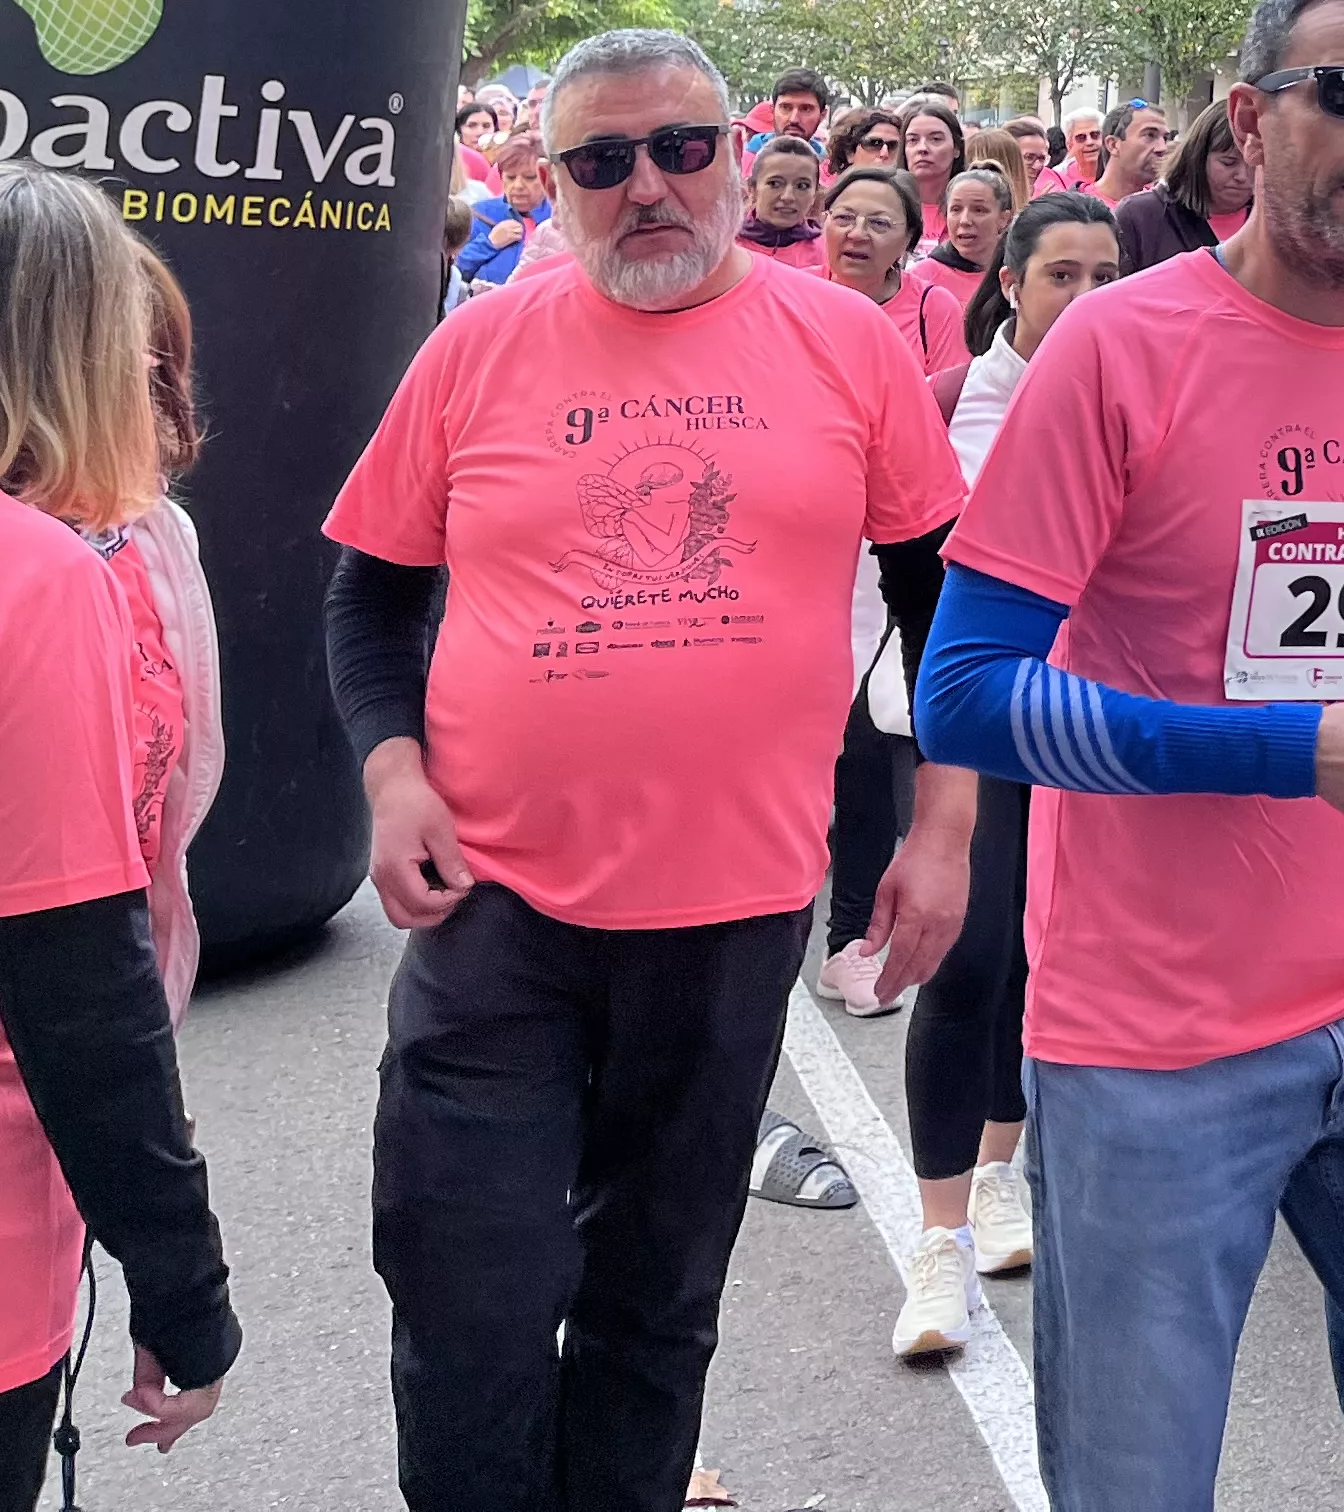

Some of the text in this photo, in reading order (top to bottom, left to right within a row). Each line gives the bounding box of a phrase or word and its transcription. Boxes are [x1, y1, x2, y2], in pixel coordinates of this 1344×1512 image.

[121, 189, 392, 232] BIOMECÁNICA
[619, 394, 746, 420] CÁNCER
[685, 415, 771, 432] HUESCA
[1276, 446, 1317, 496] 9ª
[581, 584, 740, 610] QUIÉRETE MUCHO
